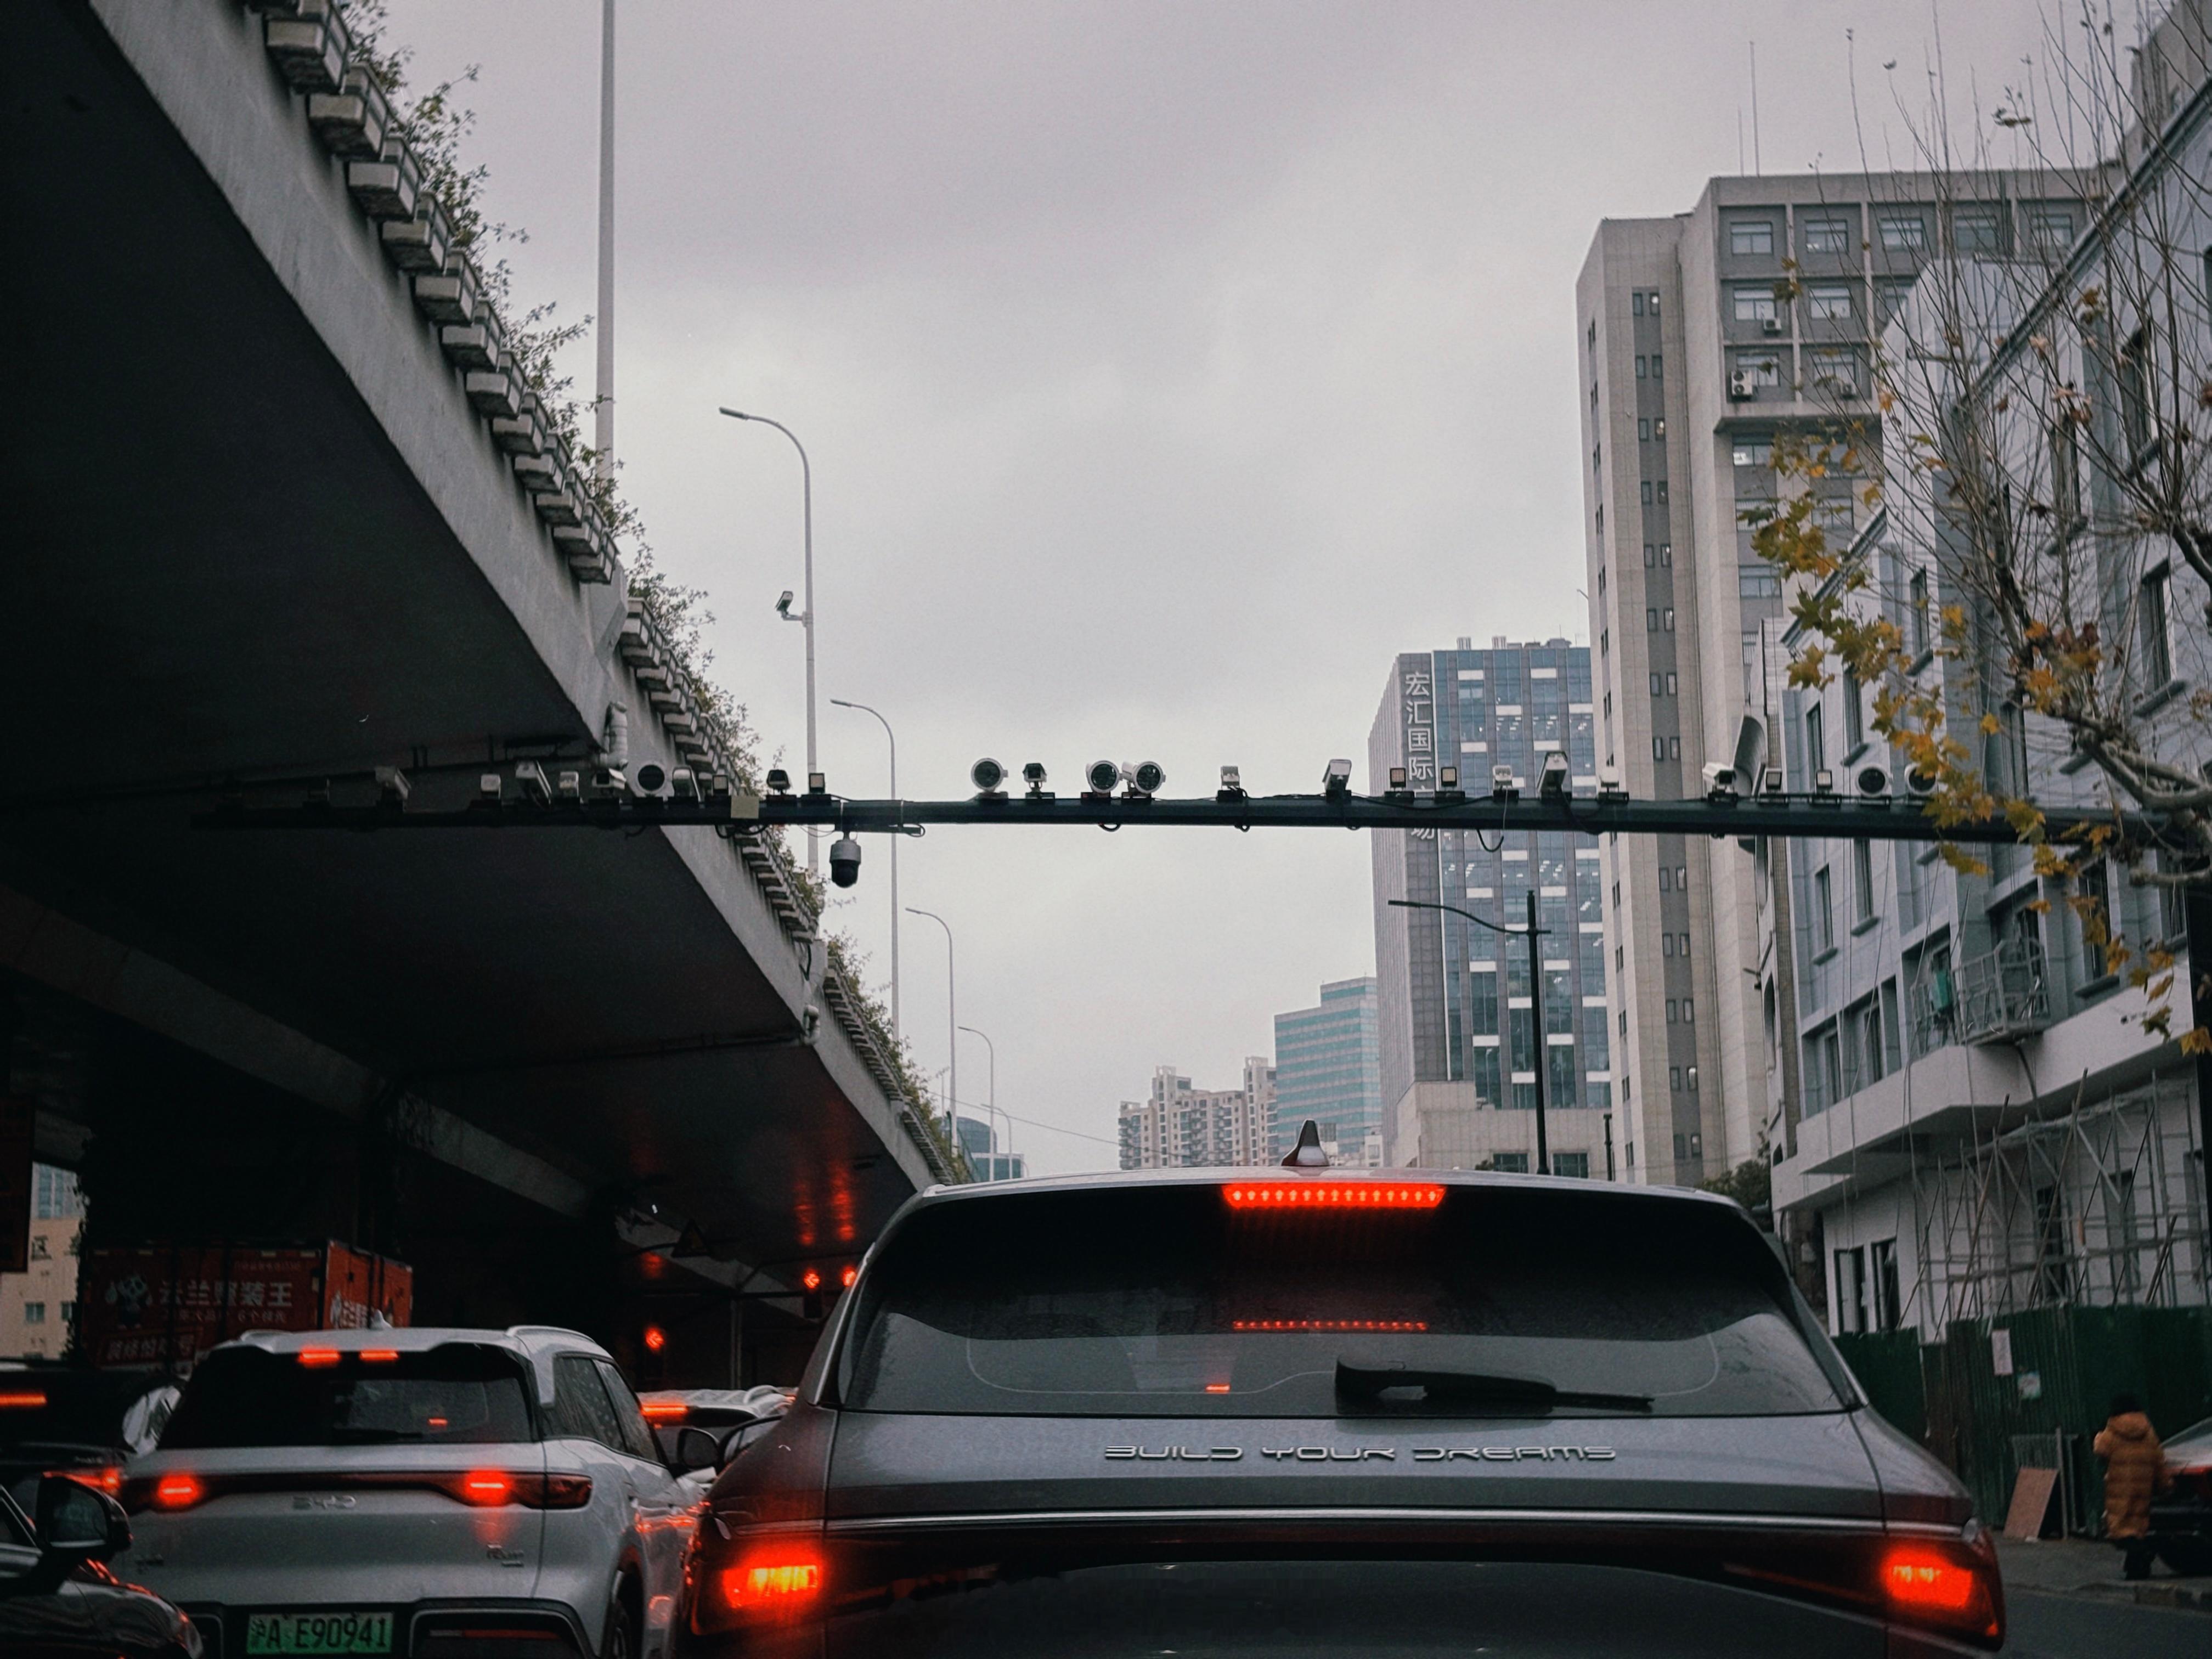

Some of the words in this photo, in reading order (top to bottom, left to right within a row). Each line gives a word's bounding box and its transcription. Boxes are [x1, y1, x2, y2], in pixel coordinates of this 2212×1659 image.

[1105, 1446, 1243, 1459] BUILD
[1262, 1446, 1396, 1460] YOUR
[1413, 1447, 1616, 1460] DREAMS
[292, 1494, 357, 1510] BYD
